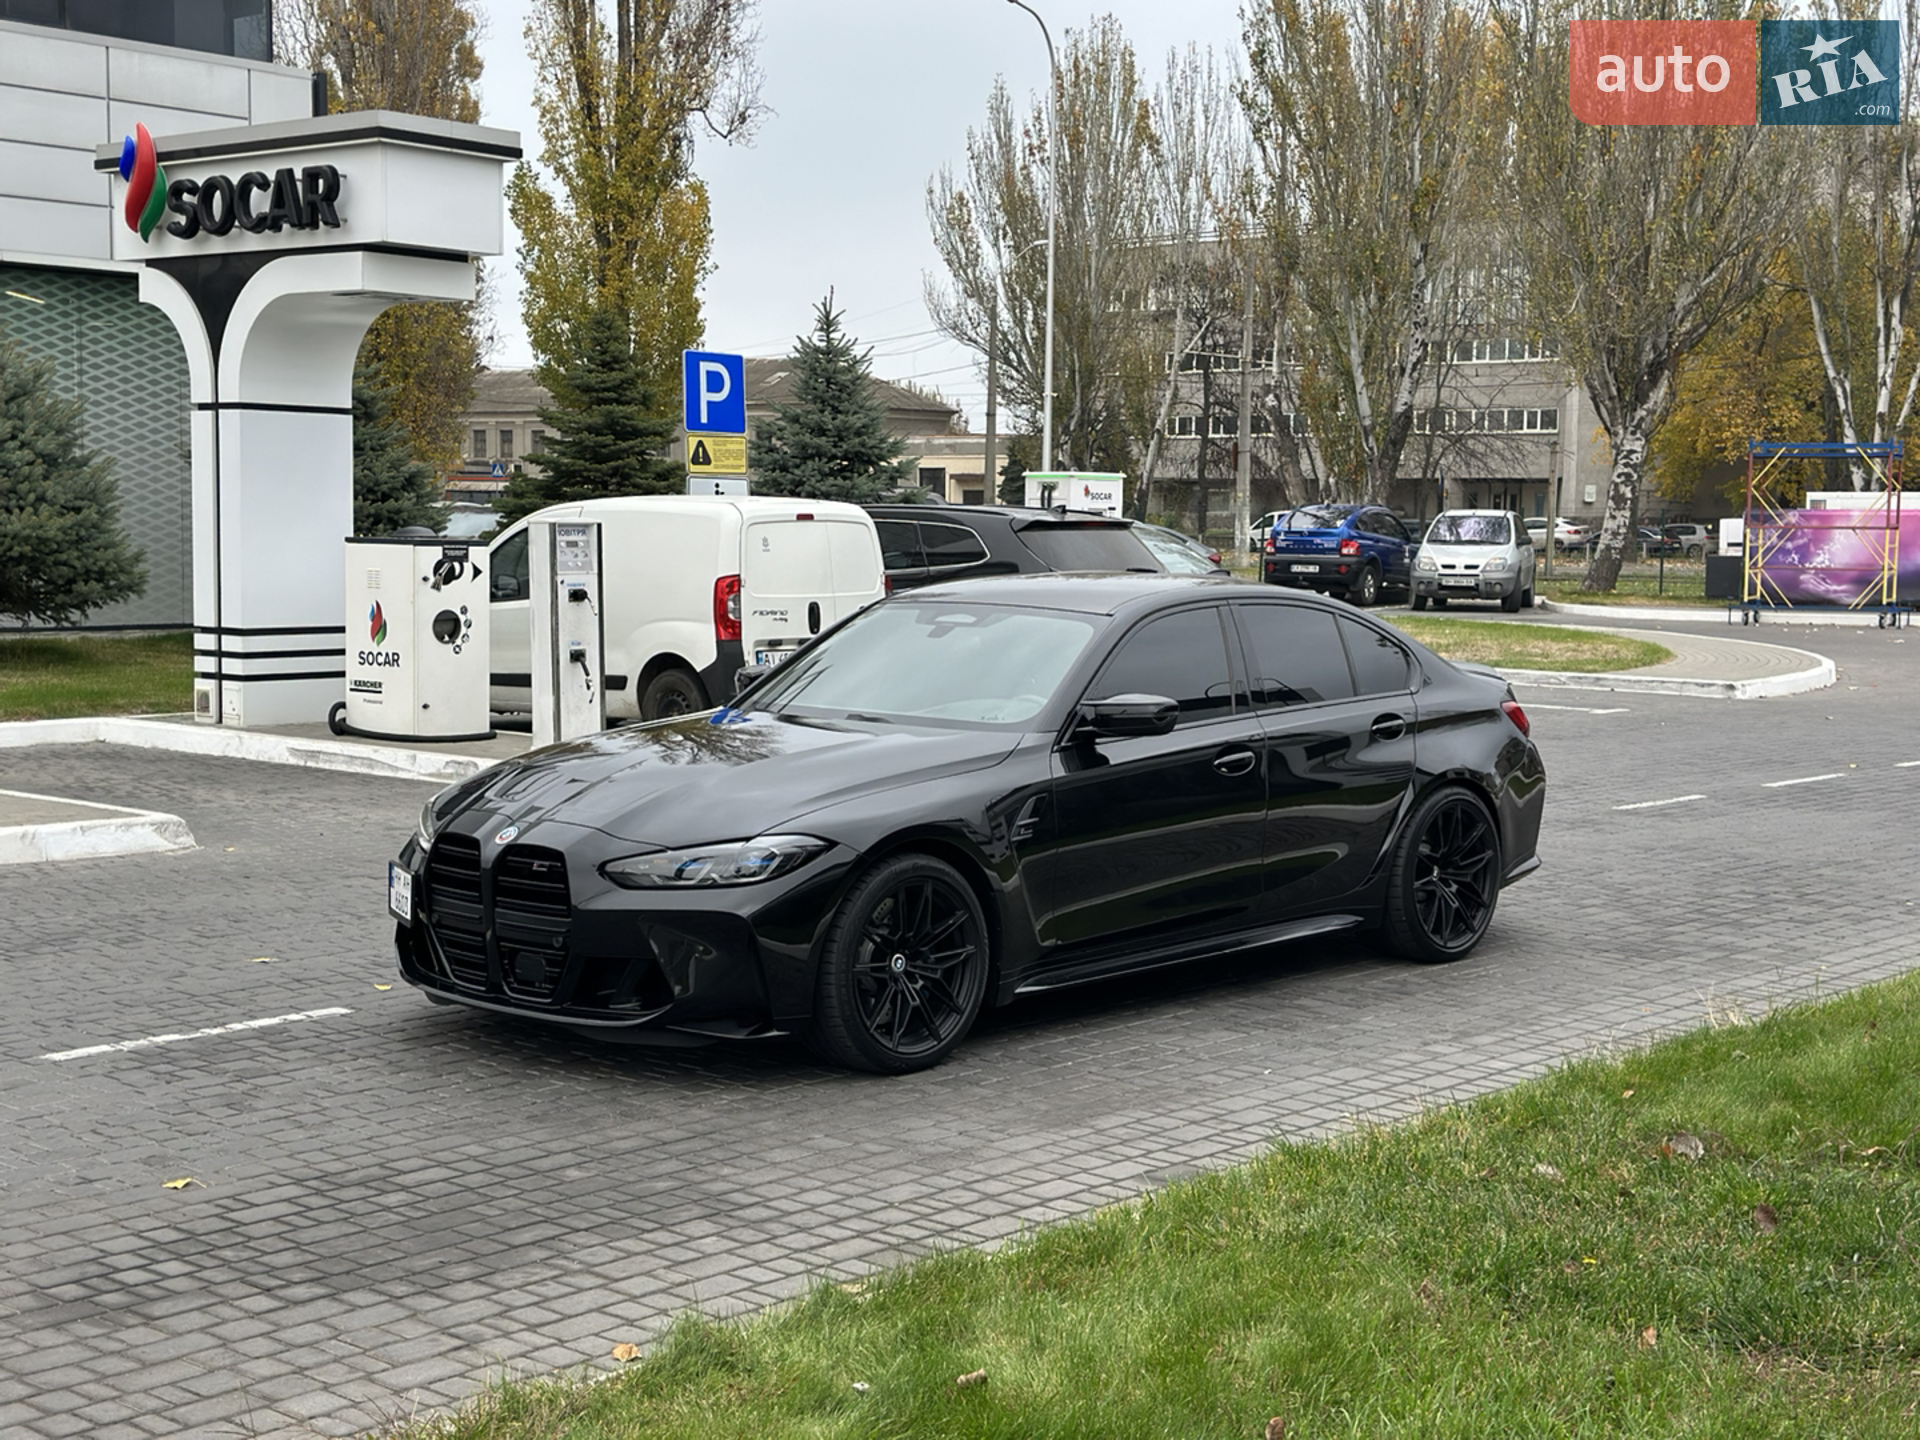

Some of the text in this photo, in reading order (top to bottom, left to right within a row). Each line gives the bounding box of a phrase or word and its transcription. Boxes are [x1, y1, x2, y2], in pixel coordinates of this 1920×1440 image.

[166, 164, 341, 240] SOCAR
[699, 360, 731, 424] P
[1090, 492, 1112, 501] SOCAR
[358, 650, 400, 668] SOCAR
